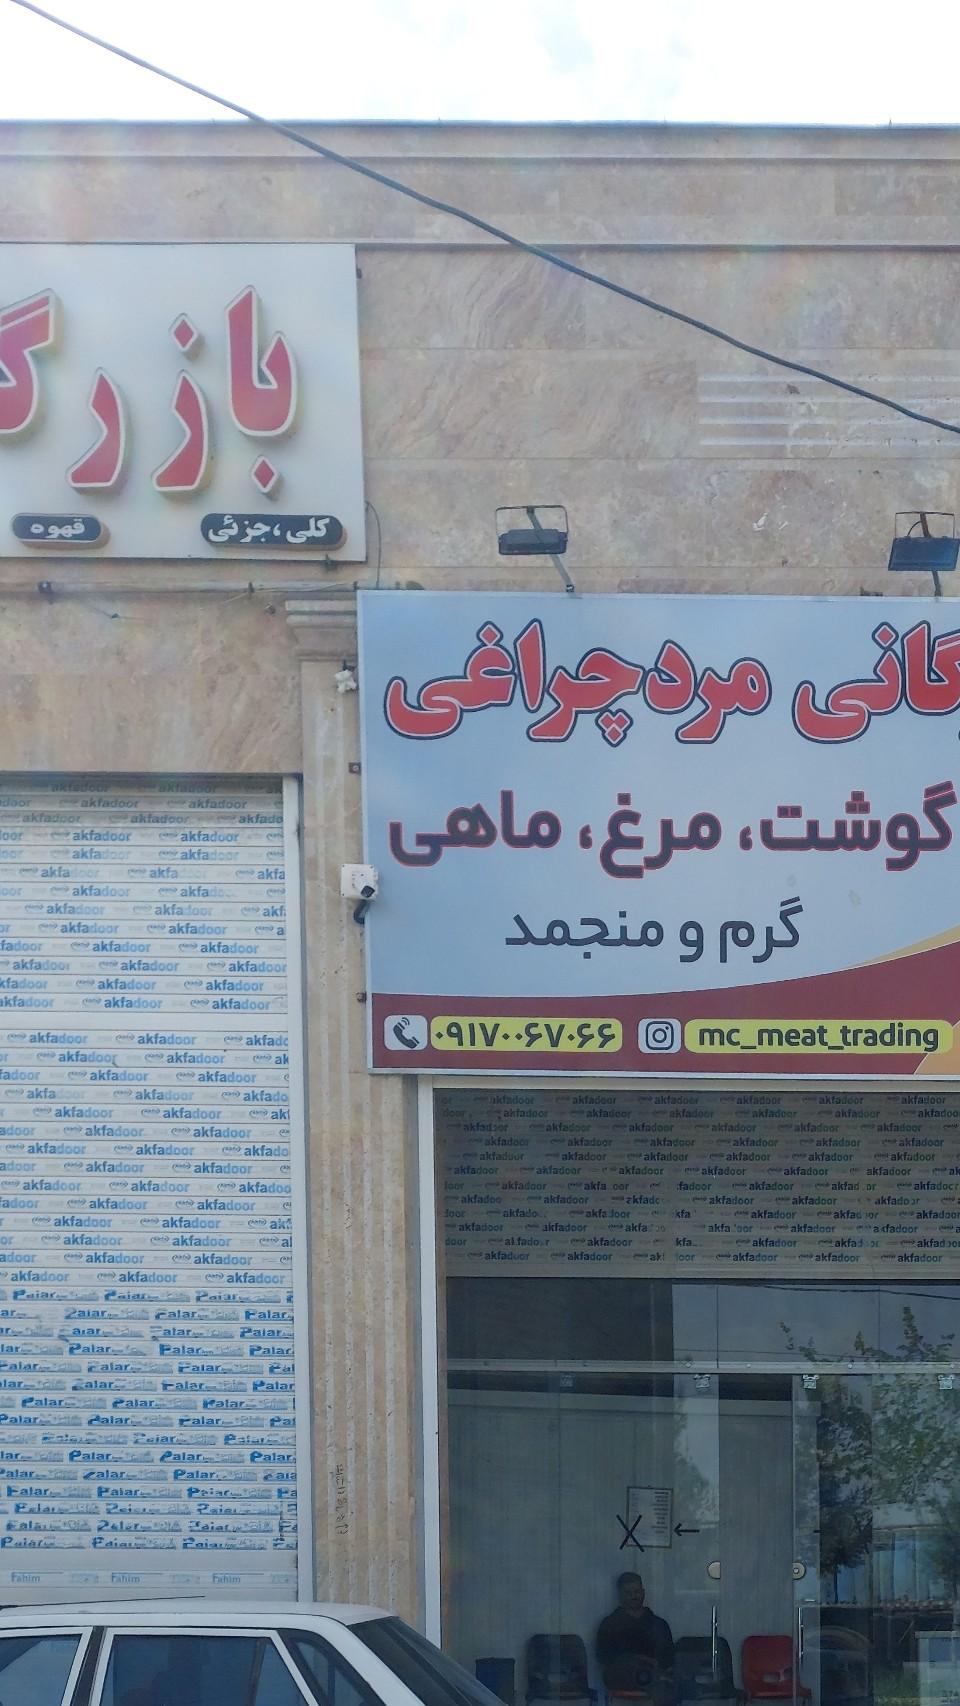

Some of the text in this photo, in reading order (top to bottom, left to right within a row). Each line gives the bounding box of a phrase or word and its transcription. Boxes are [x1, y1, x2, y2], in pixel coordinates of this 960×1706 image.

[0, 284, 297, 494] بازرگ
[30, 518, 86, 539] قهوه
[285, 516, 330, 544] کلی
[388, 789, 562, 867] ماهی
[505, 896, 803, 964] گرم و منجمد
[698, 1021, 940, 1053] mc_meat_trading
[238, 1181, 292, 1193] akfadoo
